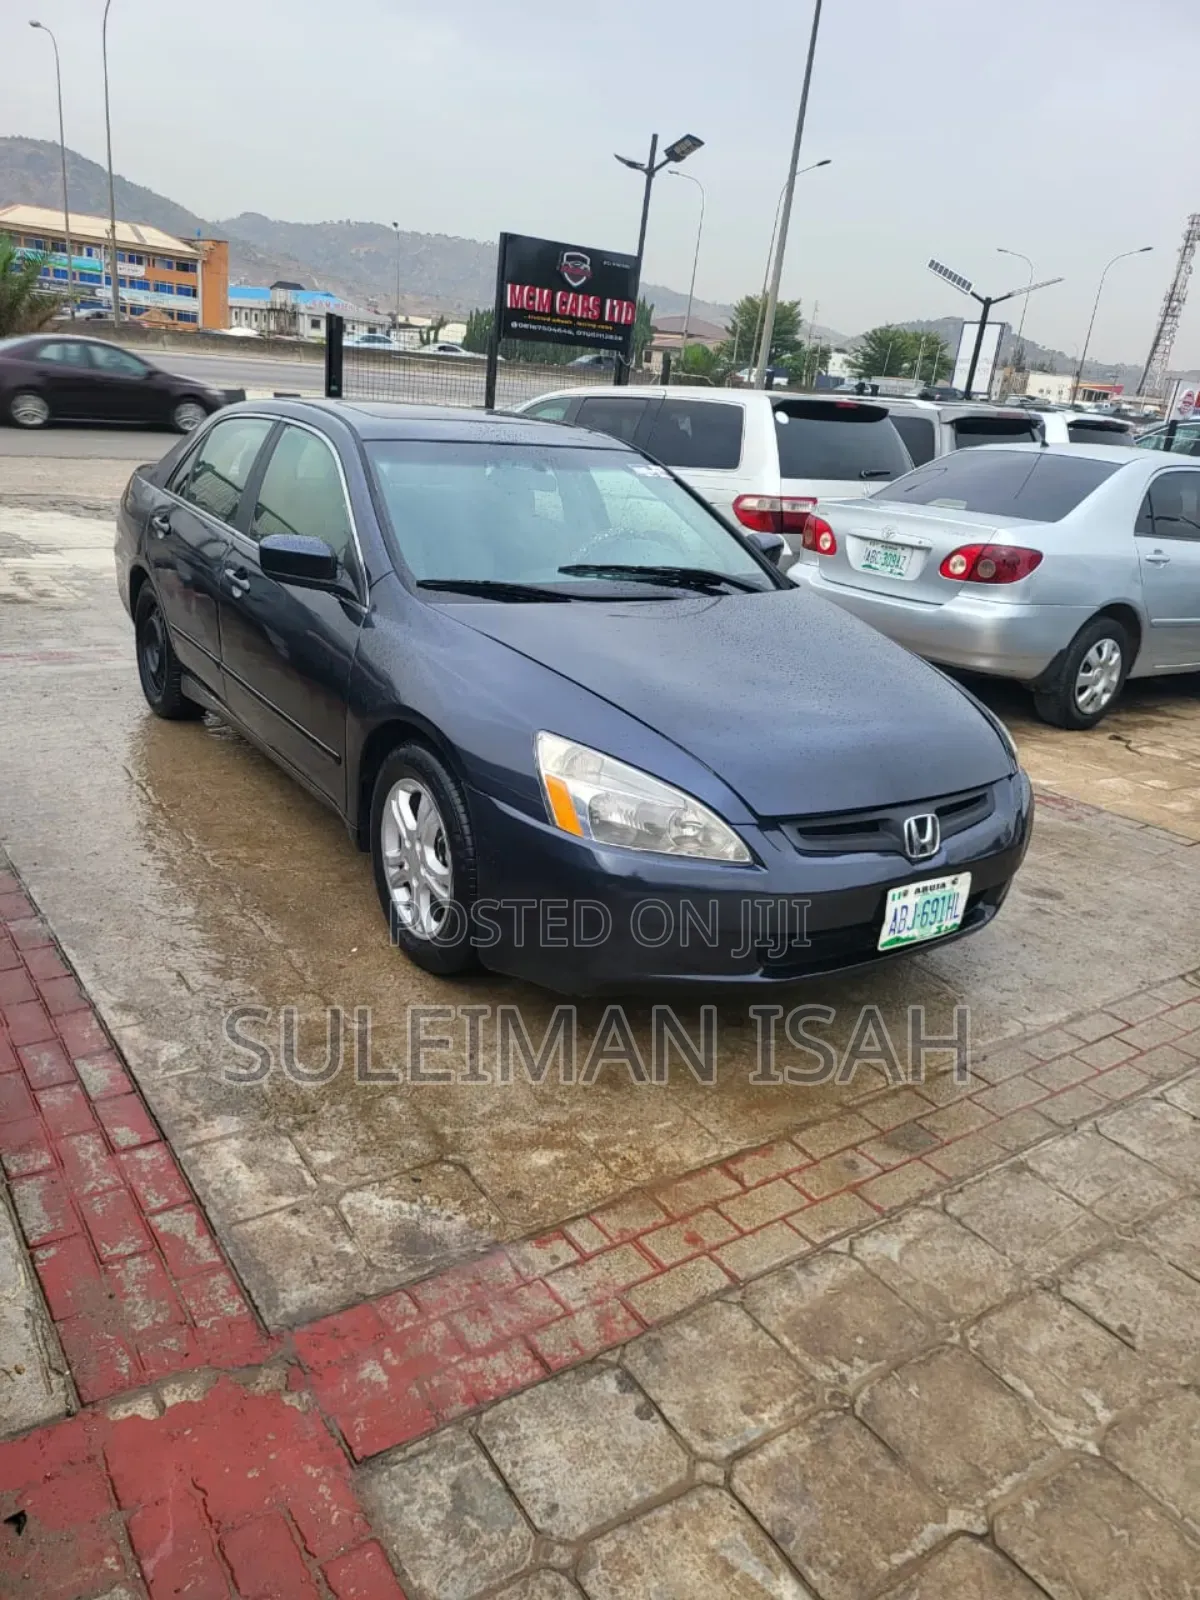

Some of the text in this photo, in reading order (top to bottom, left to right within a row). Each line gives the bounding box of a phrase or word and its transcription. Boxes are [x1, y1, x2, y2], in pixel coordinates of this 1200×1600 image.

[507, 283, 637, 325] MCM CARS LTD
